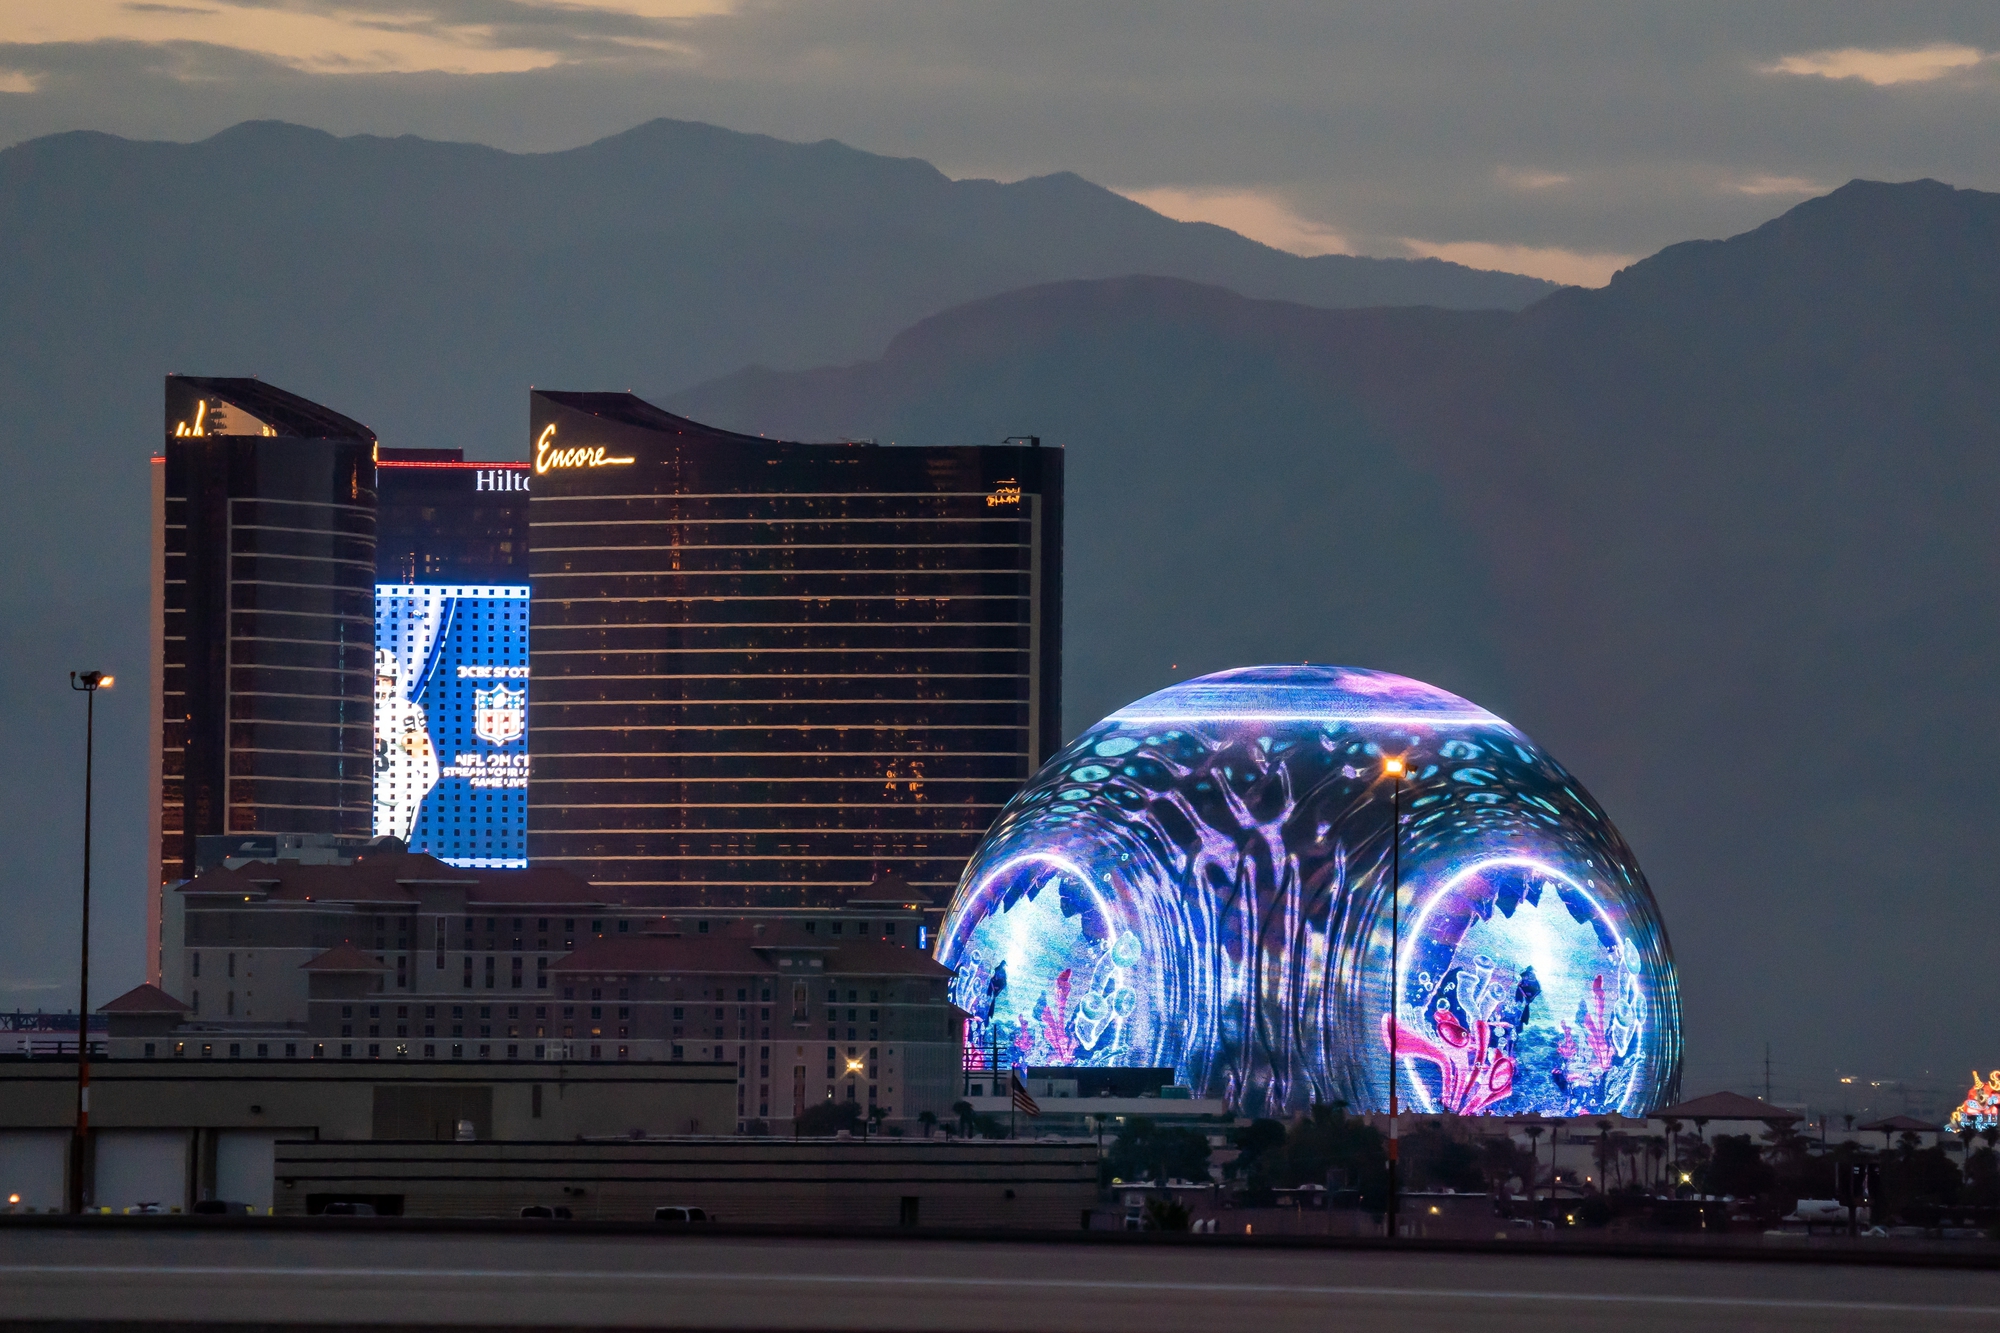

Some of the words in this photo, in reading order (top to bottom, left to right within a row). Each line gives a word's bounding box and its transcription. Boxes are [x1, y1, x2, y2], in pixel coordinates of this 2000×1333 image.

[536, 423, 635, 474] Encore
[467, 666, 493, 678] CBS
[482, 711, 518, 736] NFL
[455, 754, 485, 766] NFL
[487, 754, 511, 766] ON
[443, 767, 486, 777] STREAM
[487, 767, 518, 777] YOUR
[470, 777, 503, 787] GAME
[503, 778, 528, 787] LIVE
